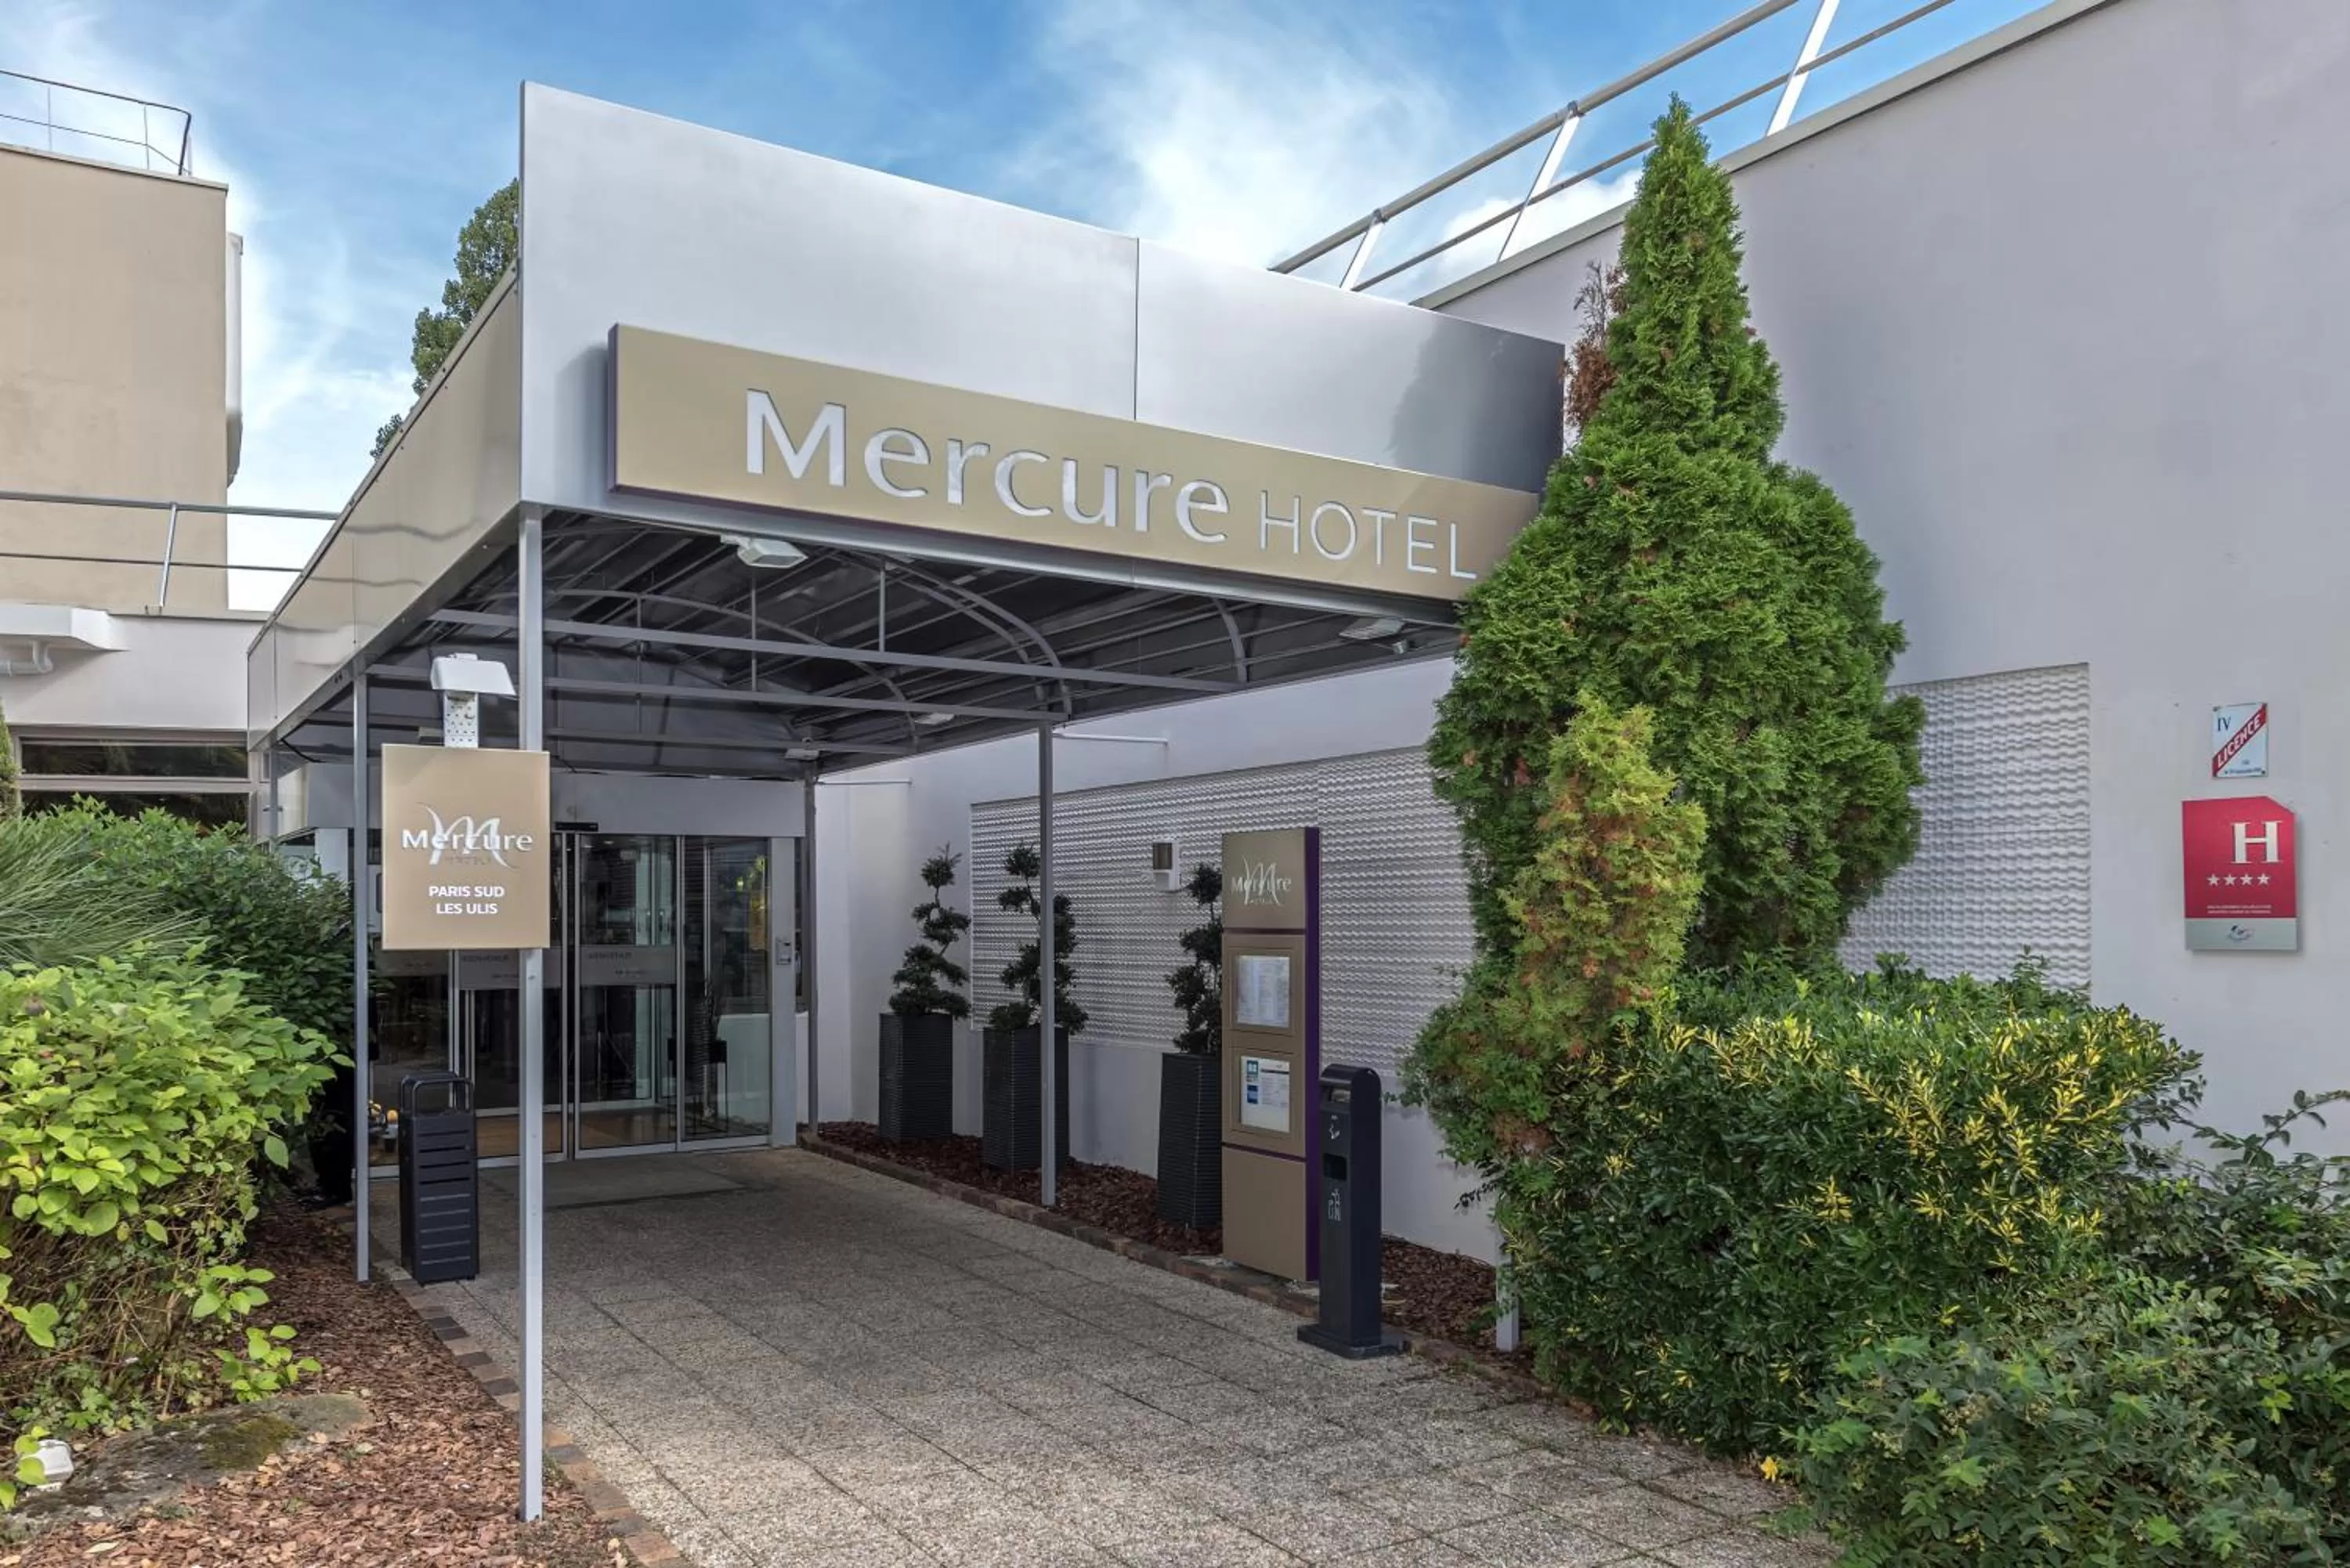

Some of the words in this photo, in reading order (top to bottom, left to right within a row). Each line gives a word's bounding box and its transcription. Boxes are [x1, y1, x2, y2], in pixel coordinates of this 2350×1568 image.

[747, 388, 1230, 542] Mercure
[1260, 490, 1477, 580] HOTEL
[2218, 716, 2231, 732] IV
[2218, 714, 2261, 768] LICENCE
[401, 828, 534, 851] Mercure
[2231, 821, 2281, 864] H
[428, 886, 471, 897] PARIS
[474, 886, 505, 897] SUD
[436, 903, 463, 914] LES
[466, 903, 498, 914] ULIS
